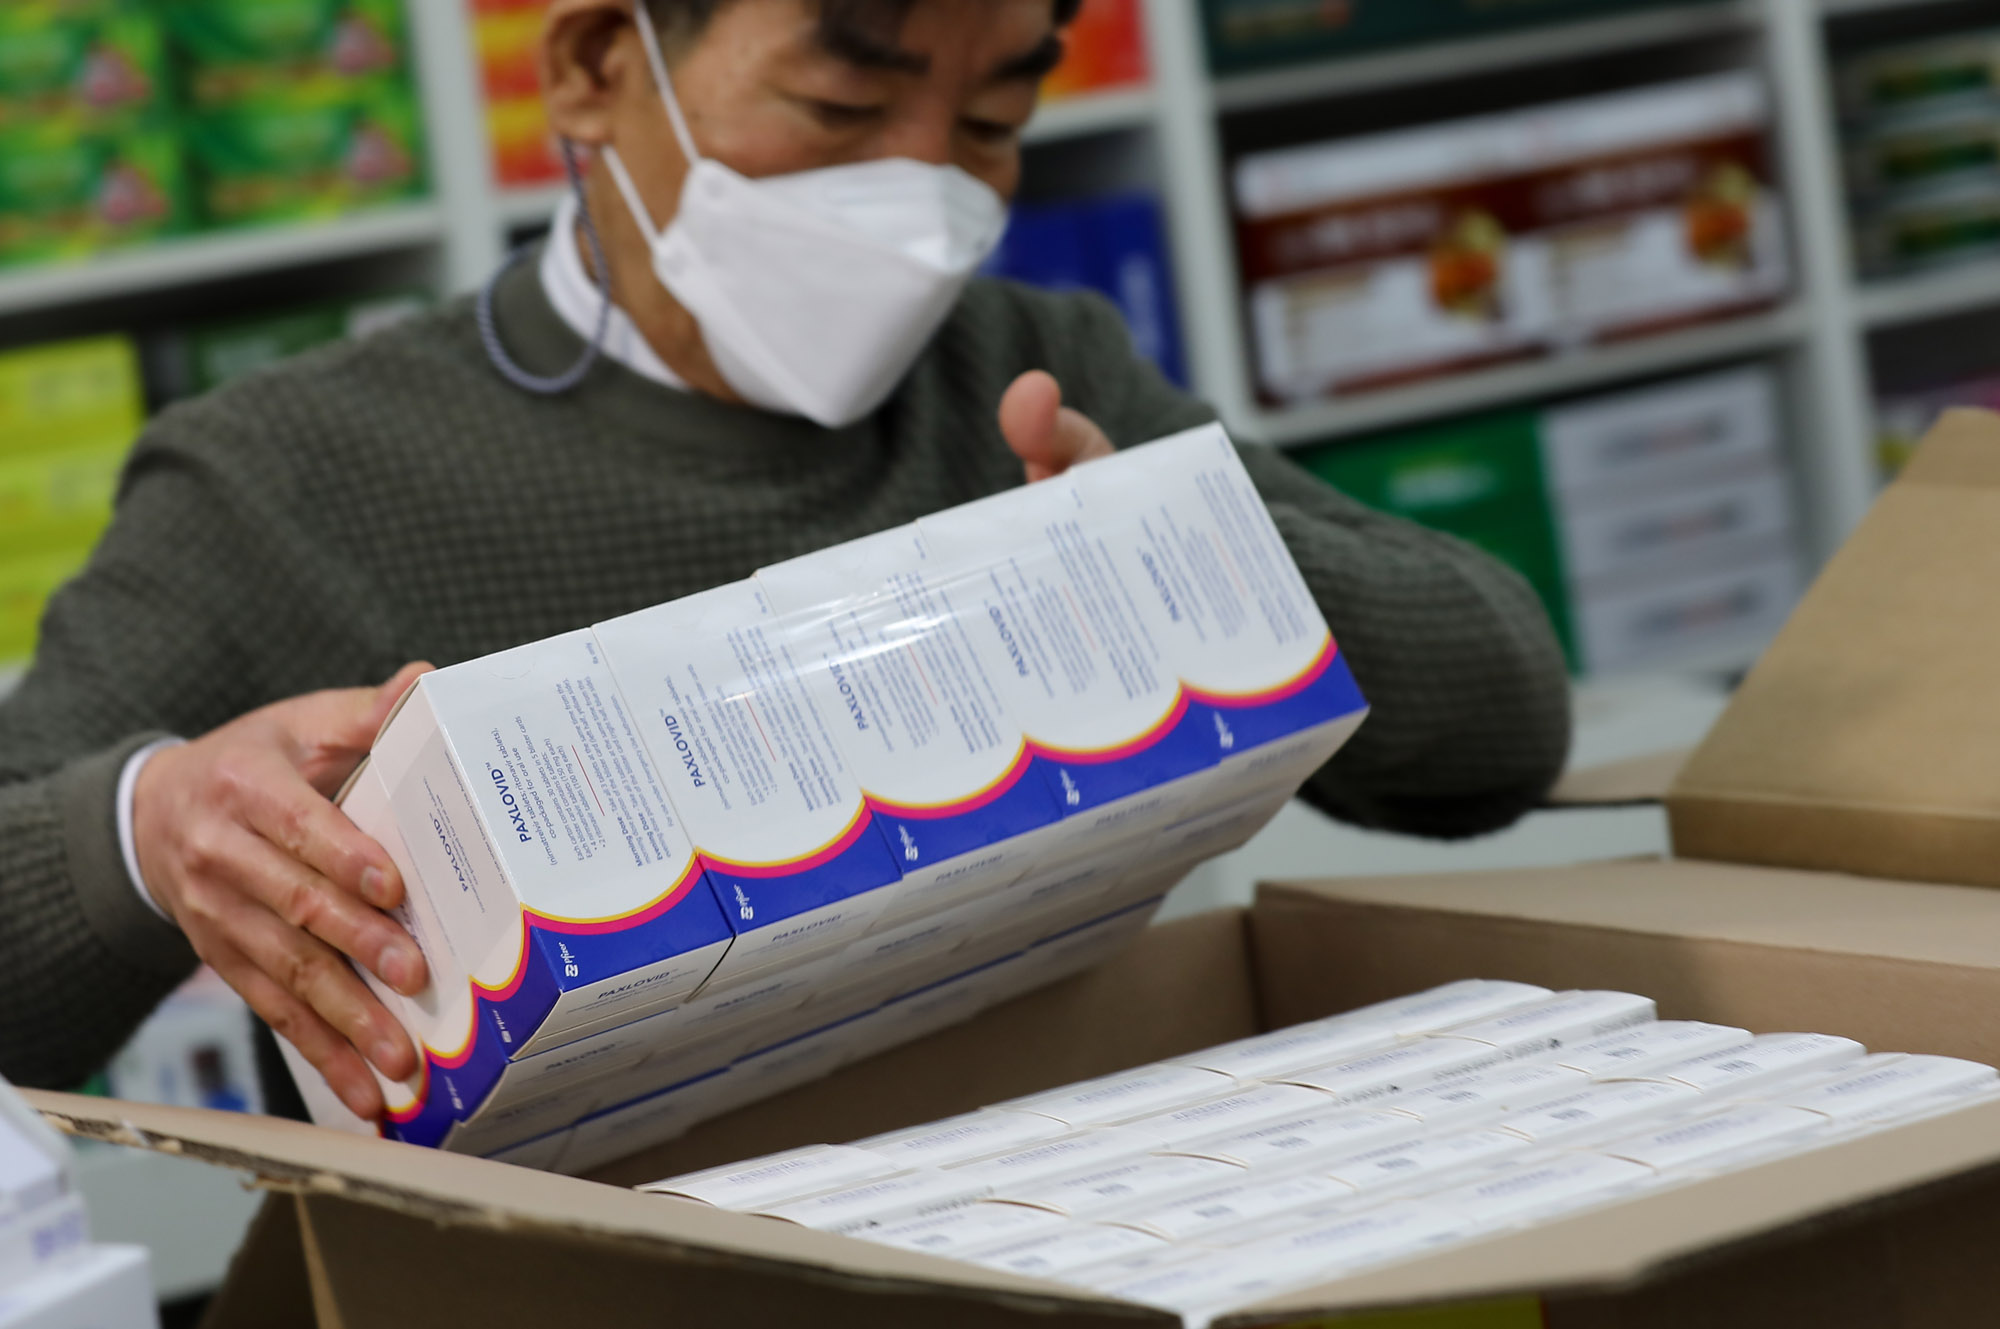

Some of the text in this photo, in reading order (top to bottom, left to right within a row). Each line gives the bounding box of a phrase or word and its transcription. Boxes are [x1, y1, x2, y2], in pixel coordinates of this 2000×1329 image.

[491, 727, 557, 865] (nirmatrelvir tablets; ritonavir tablets),
[512, 747, 556, 838] co-packaged for oral use
[558, 941, 575, 964] Pfizer
